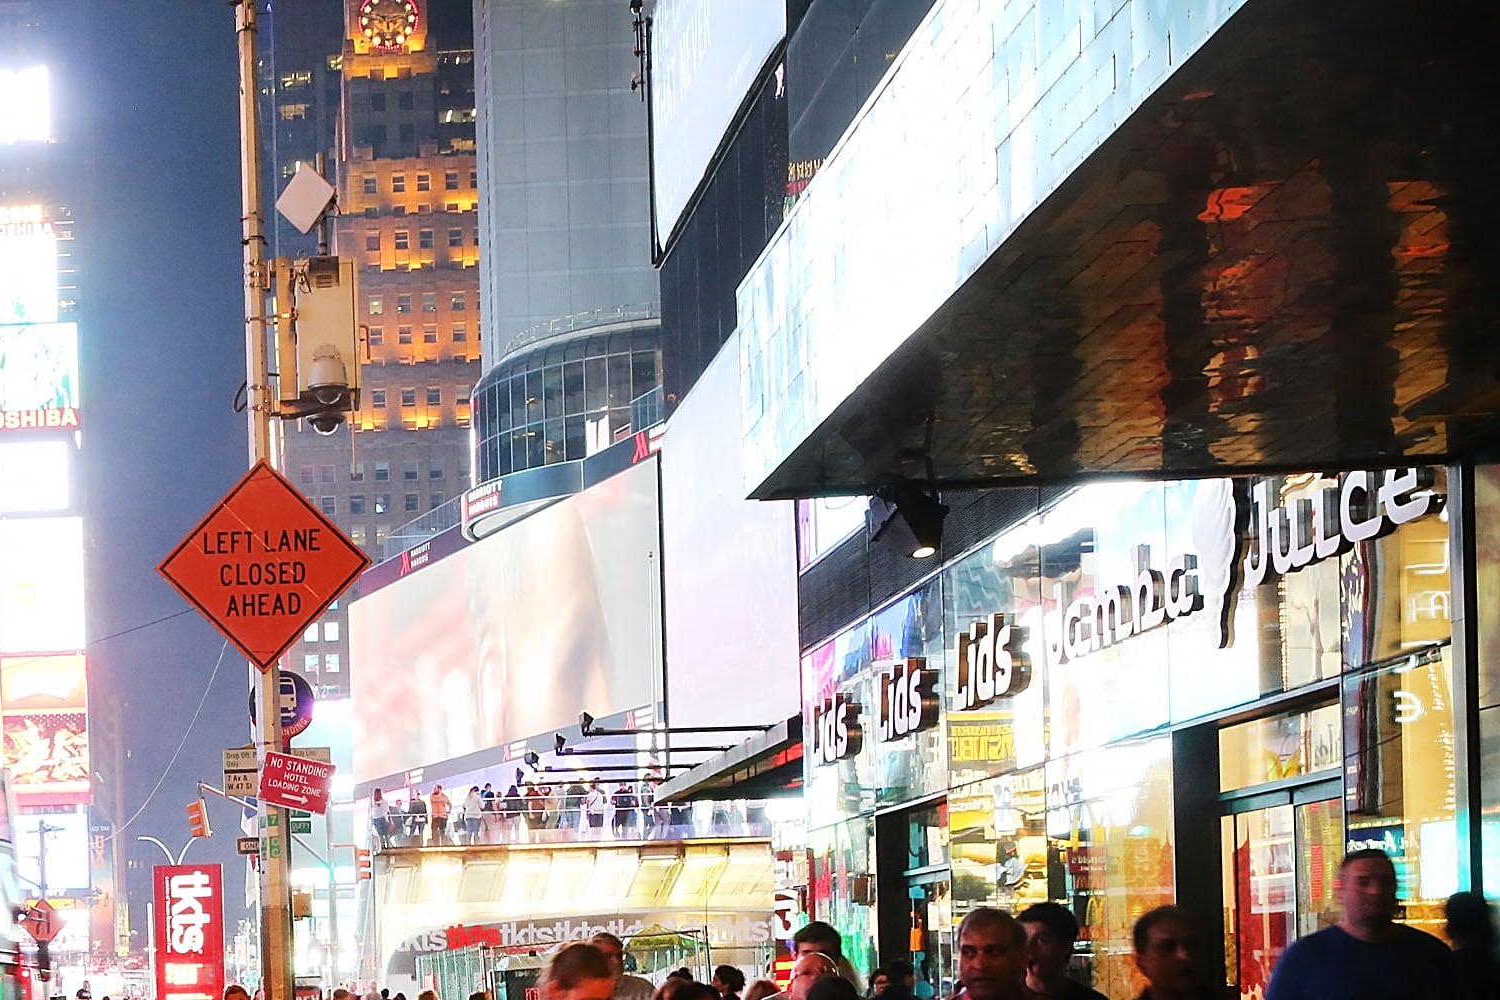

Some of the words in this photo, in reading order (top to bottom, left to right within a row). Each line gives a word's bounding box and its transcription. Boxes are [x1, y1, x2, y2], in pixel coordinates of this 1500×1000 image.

[203, 531, 254, 555] LEFT
[264, 528, 321, 554] LANE
[220, 561, 306, 587] CLOSED
[1045, 544, 1205, 664] Jamba
[1243, 466, 1431, 587] Juice
[226, 592, 302, 617] AHEAD
[953, 613, 1013, 711] Lids
[873, 656, 922, 743] Lids
[811, 695, 848, 768] Lids
[271, 757, 283, 768] NO
[286, 760, 329, 779] STANDING
[283, 772, 309, 785] HOTEL
[268, 778, 300, 794] LOADING
[301, 786, 322, 798] ZONE
[170, 870, 213, 954] tkts
